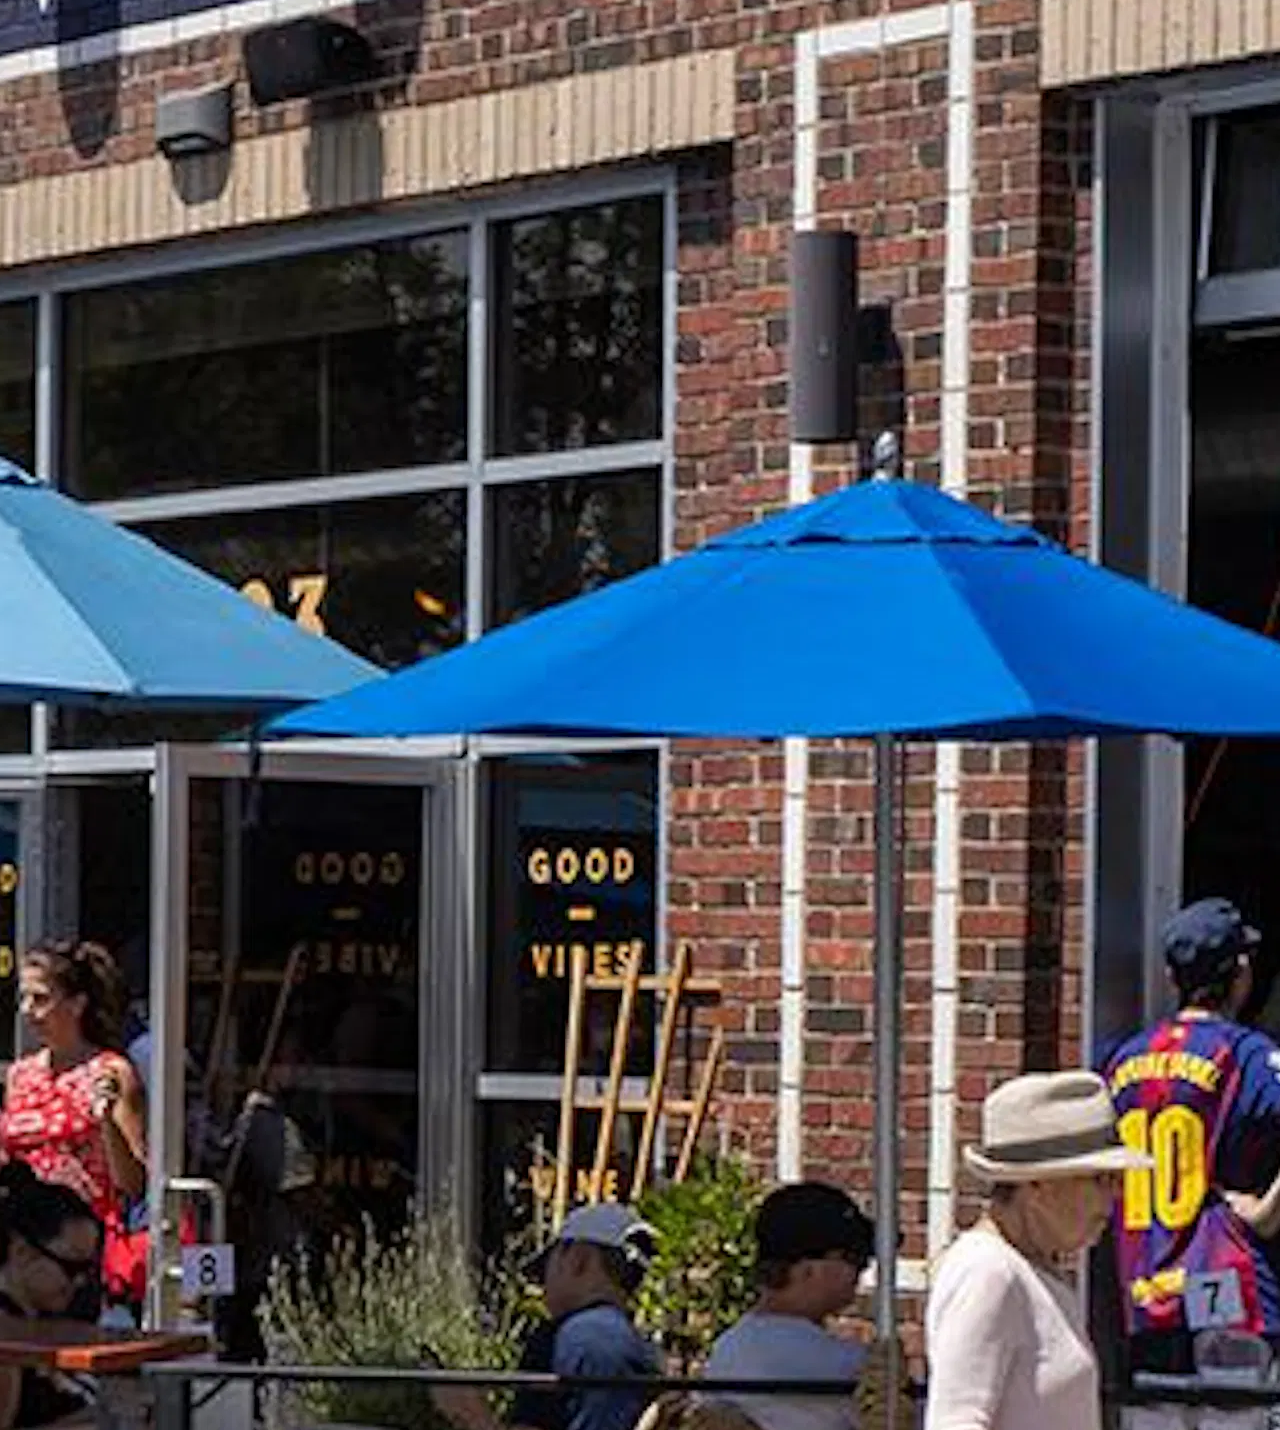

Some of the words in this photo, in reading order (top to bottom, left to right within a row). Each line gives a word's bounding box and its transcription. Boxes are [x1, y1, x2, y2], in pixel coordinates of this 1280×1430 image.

[528, 846, 635, 885] GOOD
[1117, 1104, 1207, 1232] 10
[199, 1253, 217, 1286] 8
[1203, 1282, 1220, 1314] 7
